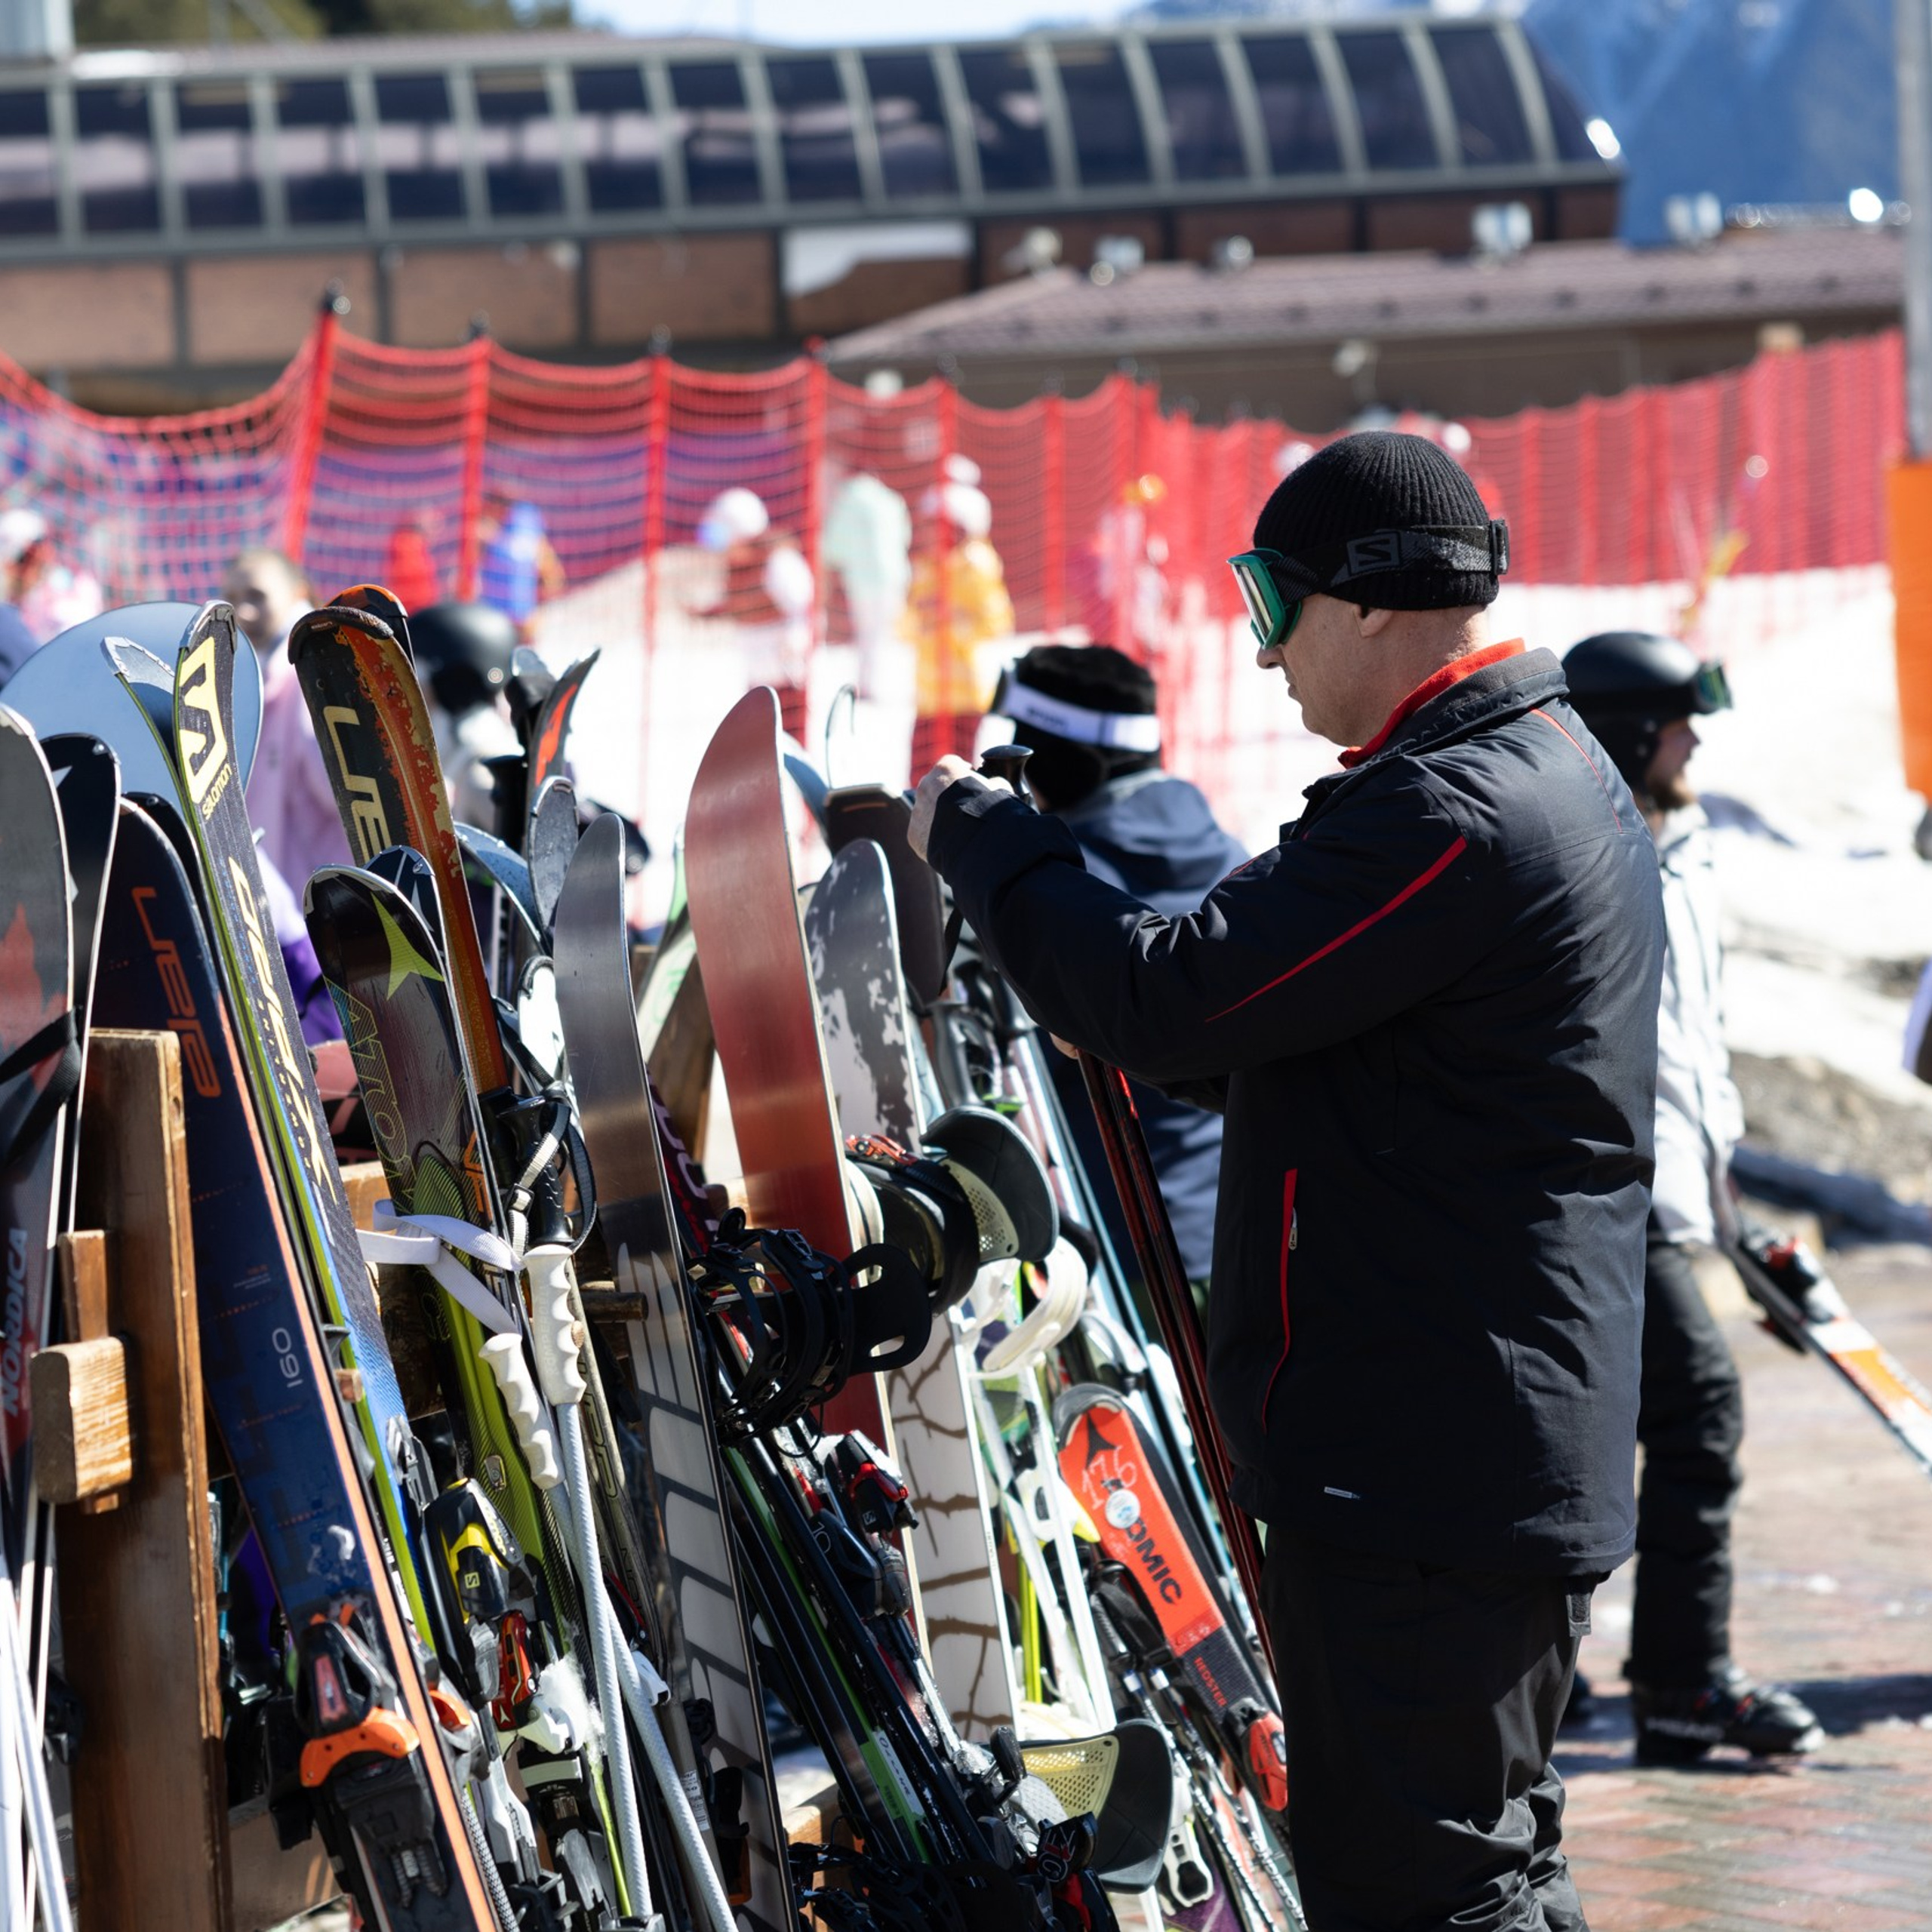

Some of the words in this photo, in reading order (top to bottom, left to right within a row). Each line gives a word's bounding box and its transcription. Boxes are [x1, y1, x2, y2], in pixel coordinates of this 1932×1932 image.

[201, 763, 232, 820] salomon
[131, 887, 221, 1098] elan
[1, 1227, 28, 1418] NORDICA
[272, 1326, 303, 1389] 160
[1100, 1476, 1183, 1606] AOMIC
[1193, 1655, 1228, 1708] REDSTER
